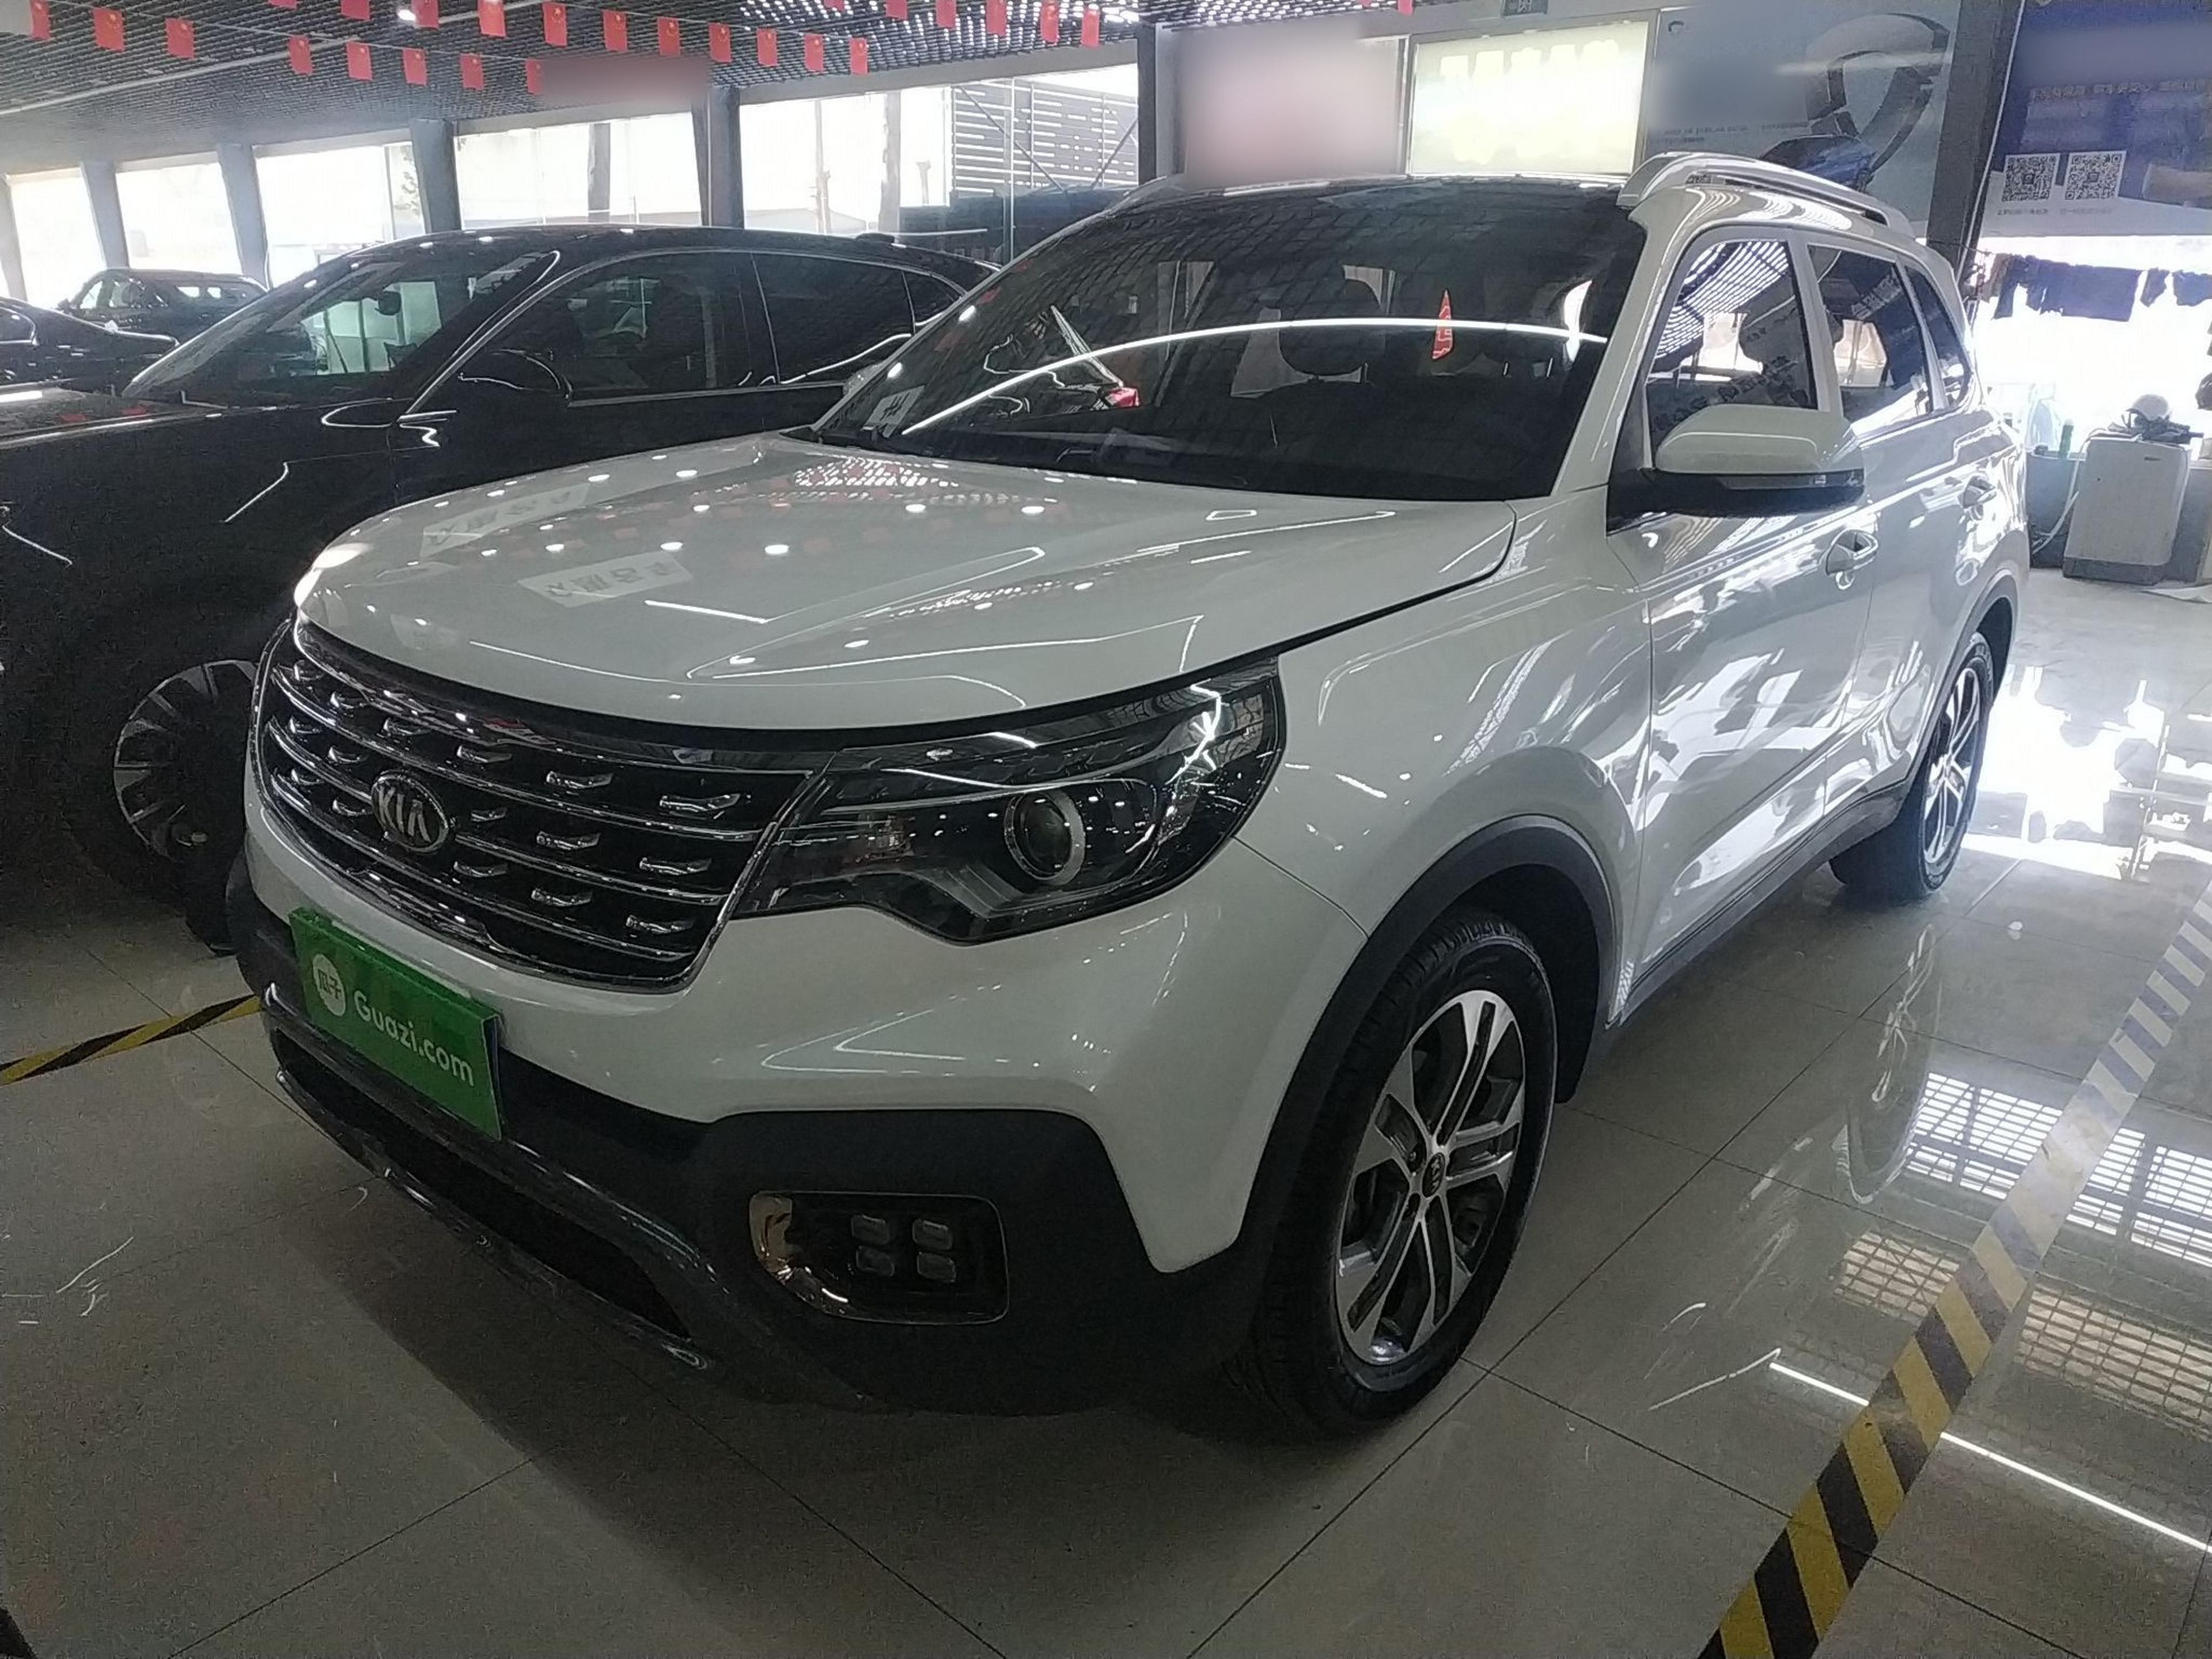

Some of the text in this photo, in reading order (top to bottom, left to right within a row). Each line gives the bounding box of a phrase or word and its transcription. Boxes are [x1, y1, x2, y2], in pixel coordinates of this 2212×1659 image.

[378, 786, 431, 843] KIA
[317, 968, 342, 1001] 瓜子
[354, 990, 474, 1086] Guazi.com
